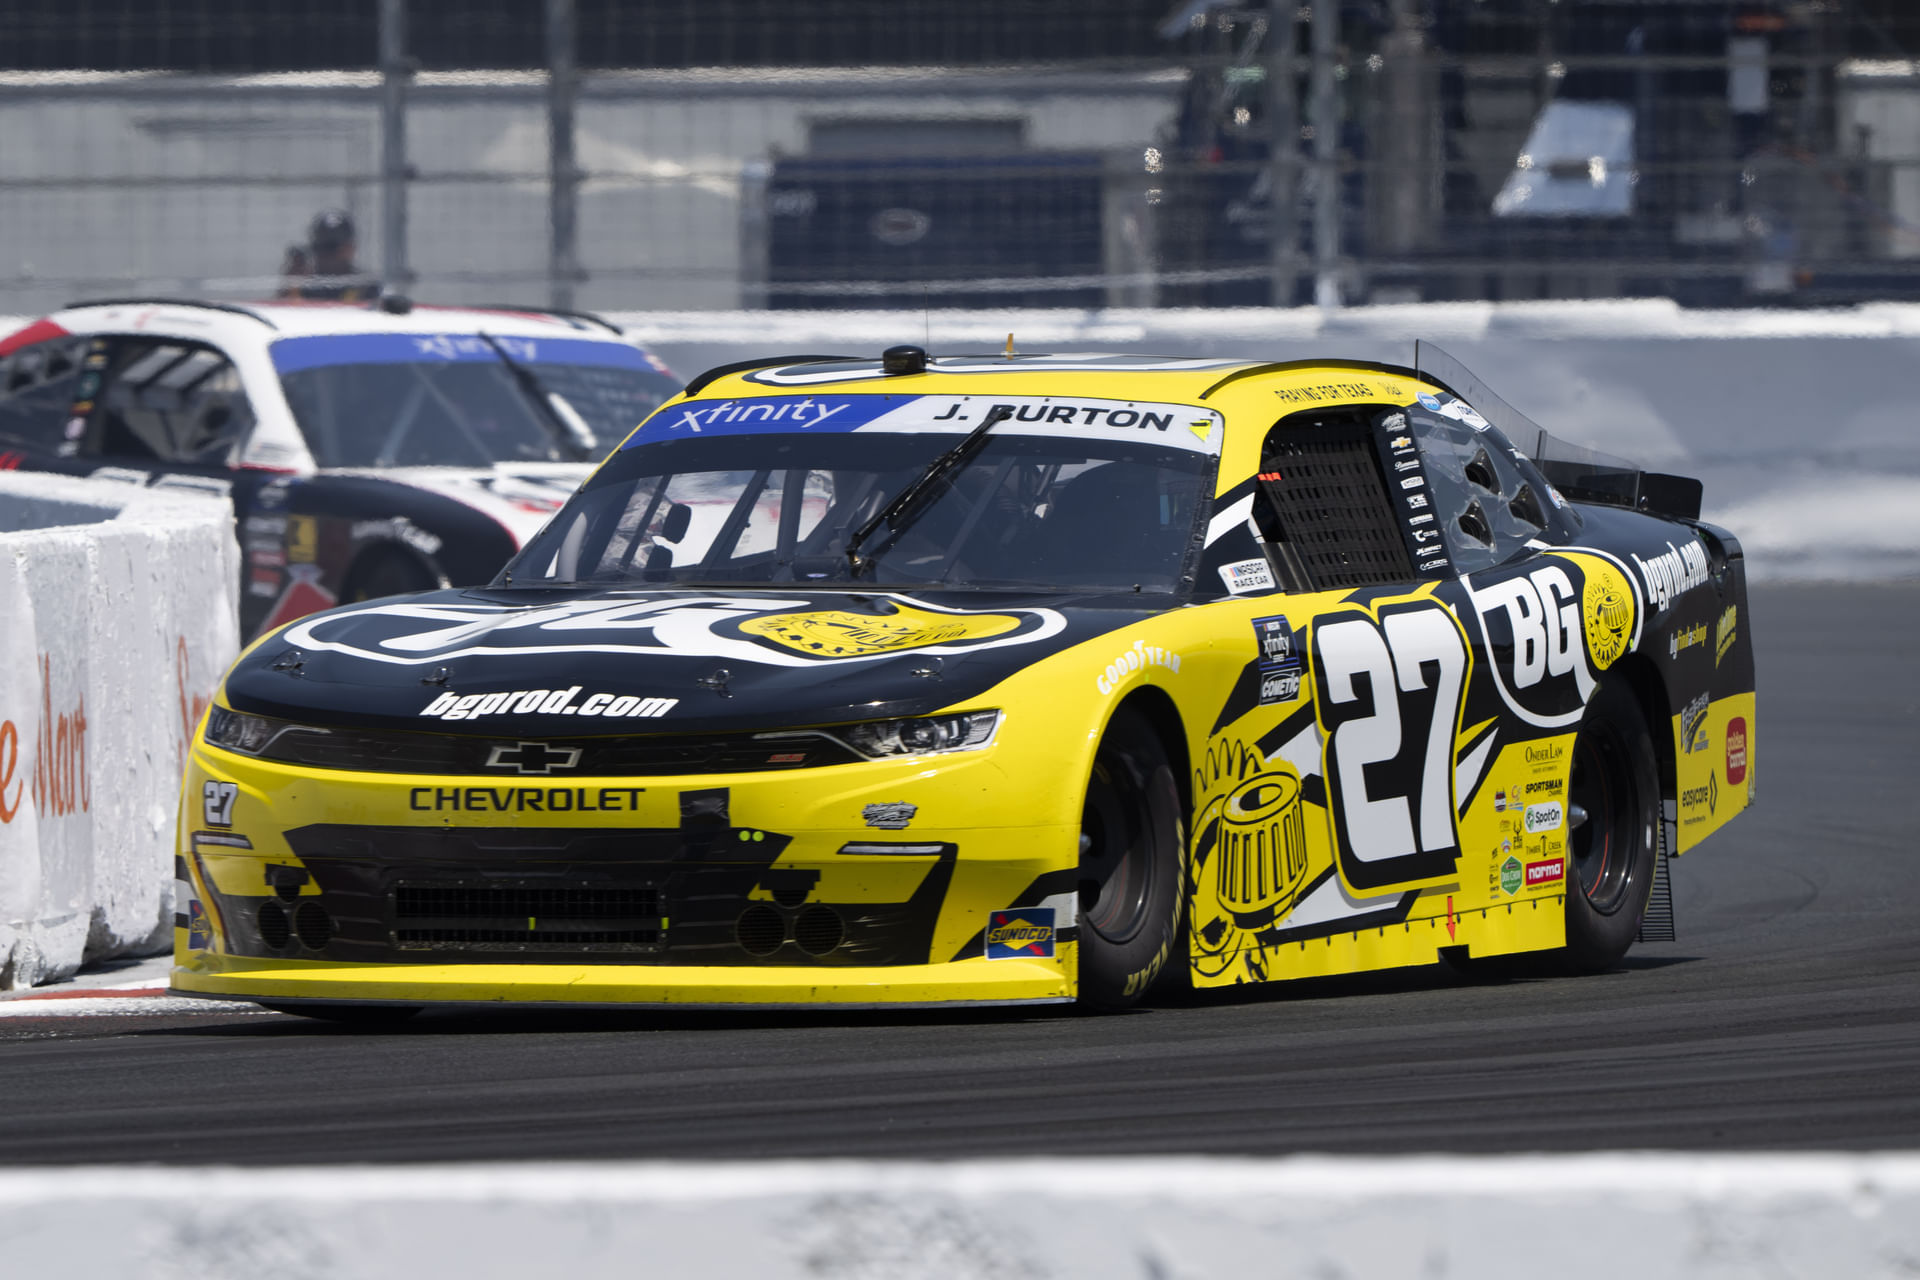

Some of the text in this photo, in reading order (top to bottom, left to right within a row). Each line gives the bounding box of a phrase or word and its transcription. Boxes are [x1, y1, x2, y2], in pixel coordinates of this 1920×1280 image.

[1274, 386, 1321, 404] PRAYING
[1318, 384, 1341, 400] FOR
[1337, 383, 1375, 398] TEXAS
[671, 398, 851, 433] xfinity
[933, 403, 1175, 432] J. BURTON
[1234, 575, 1269, 589] RACE CAR
[1238, 562, 1264, 576] NASCAR
[1630, 540, 1709, 612] bgprod.com
[1474, 565, 1585, 695] BG
[1263, 632, 1290, 659] xfinity
[1096, 640, 1182, 695] GOODYEAR
[1262, 672, 1300, 699] COMETIC
[419, 685, 680, 720] bgprod.com
[1317, 606, 1467, 864] 27
[410, 787, 647, 812] CHEVROLET
[1525, 778, 1563, 794] SPORTSMAN
[203, 780, 239, 827] 27
[1535, 808, 1560, 825] SpotOn
[1528, 863, 1562, 880] norma
[990, 927, 1051, 942] SUNOCO
